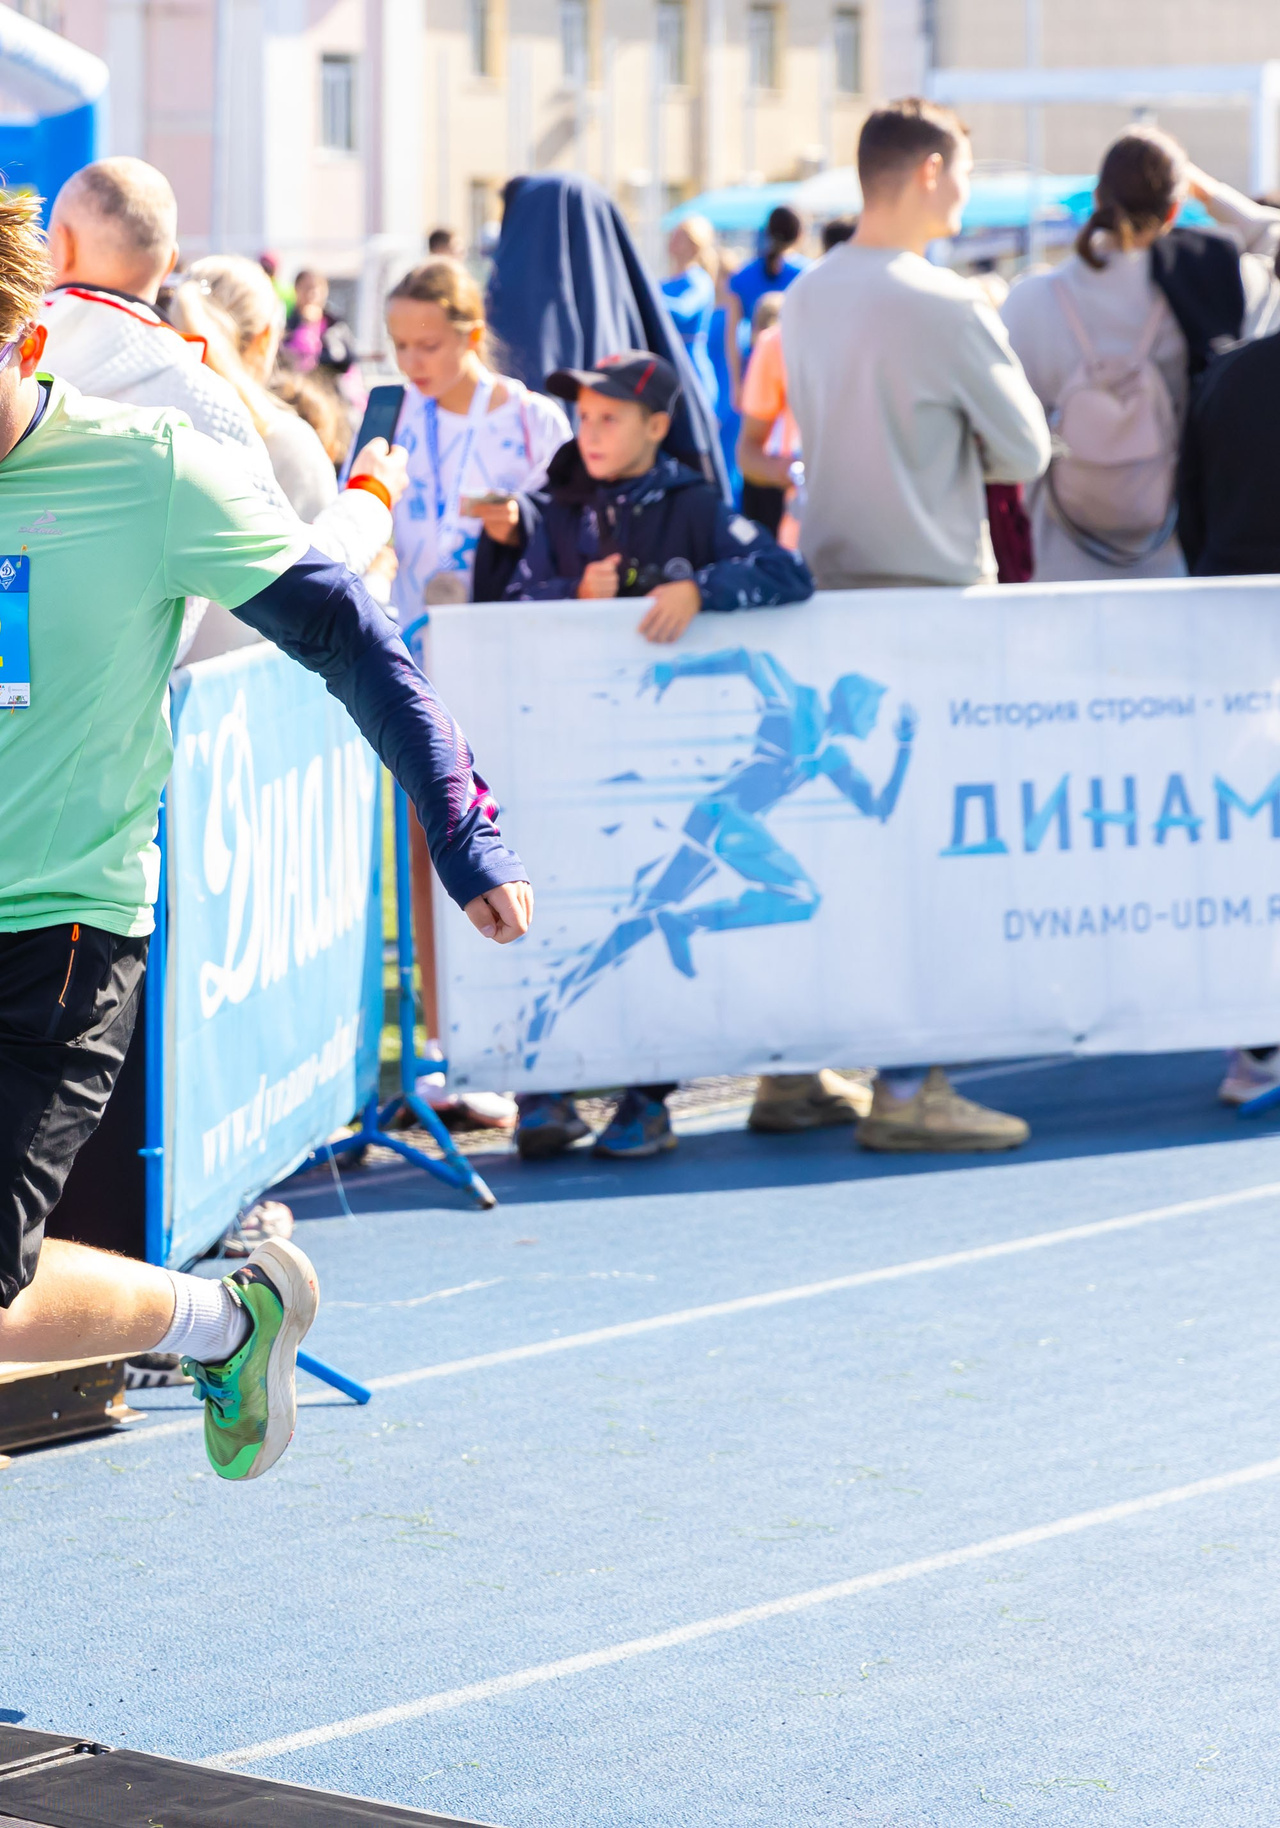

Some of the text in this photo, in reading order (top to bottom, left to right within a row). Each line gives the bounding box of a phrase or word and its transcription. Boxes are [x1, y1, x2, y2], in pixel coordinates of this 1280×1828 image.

[949, 697, 1078, 729] История
[1087, 693, 1196, 725] страны
[938, 771, 1280, 858] ДИНАМ
